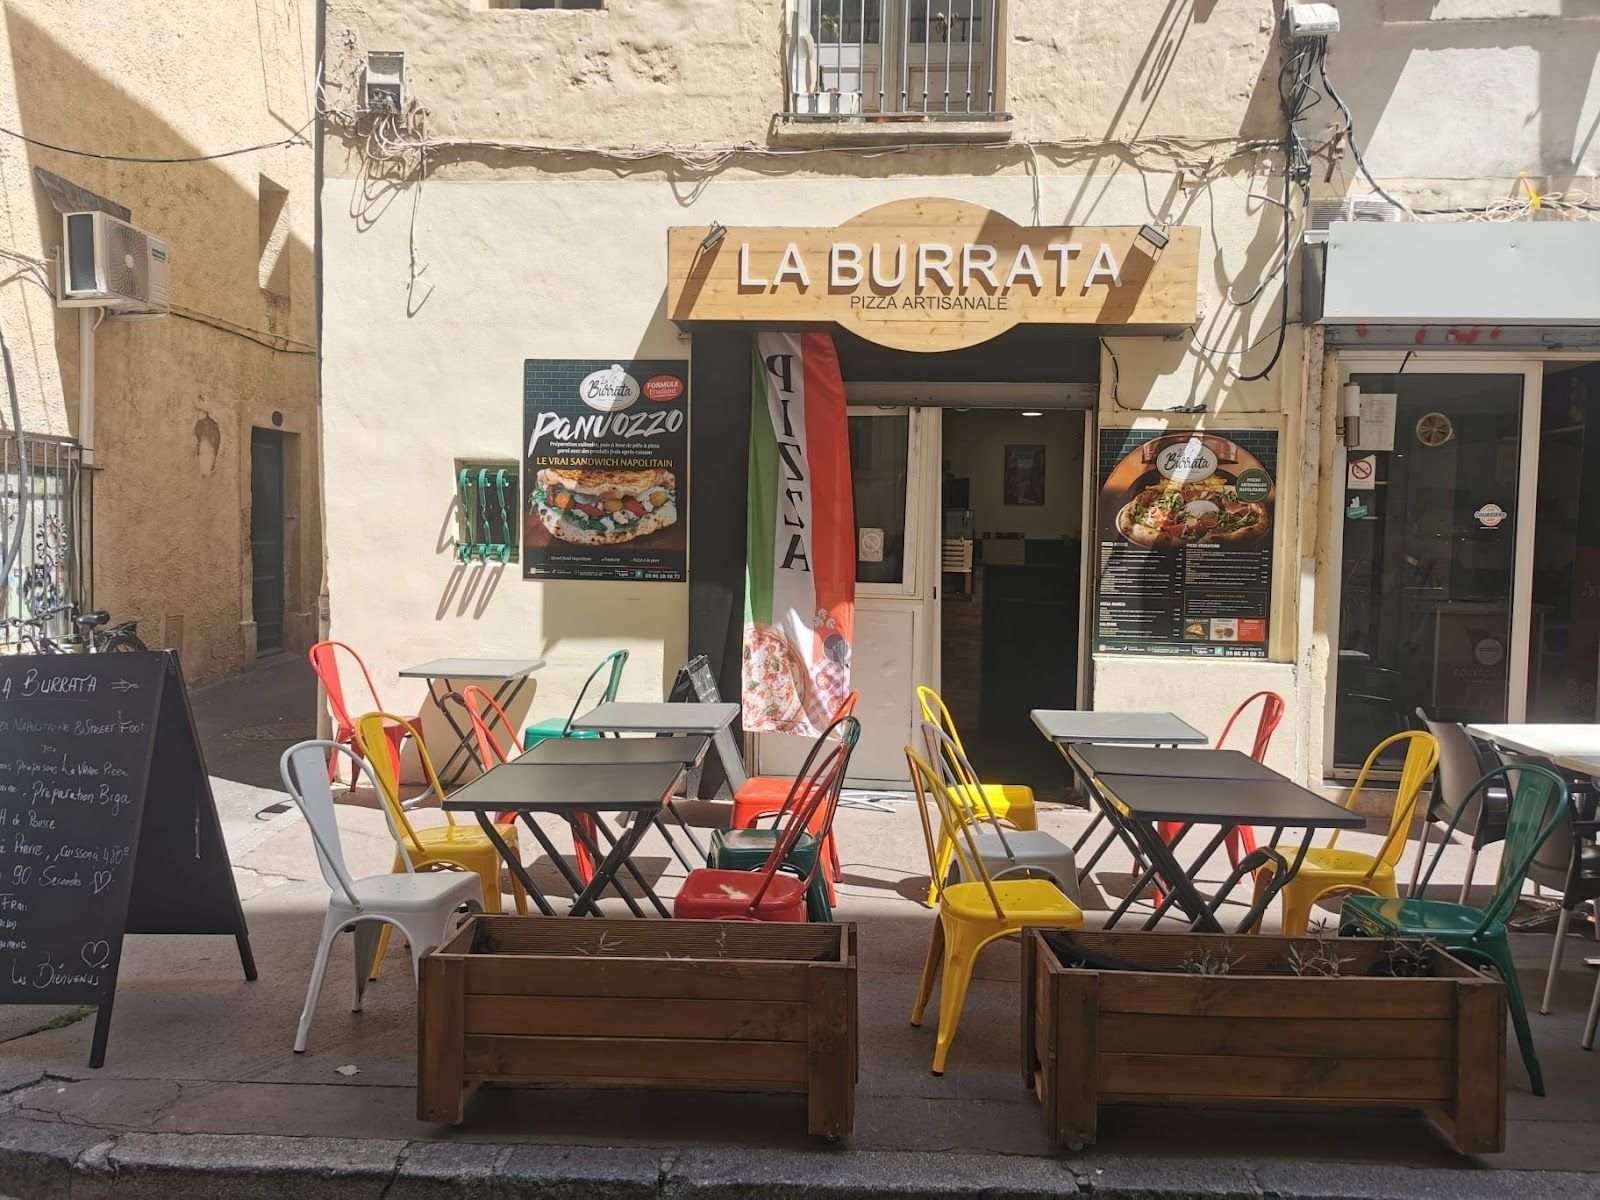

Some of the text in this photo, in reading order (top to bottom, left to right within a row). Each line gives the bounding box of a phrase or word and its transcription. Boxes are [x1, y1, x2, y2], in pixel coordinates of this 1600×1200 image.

[740, 243, 1122, 289] LA BURRATA
[850, 296, 1008, 311] PIZZA ARTISANALE
[587, 379, 633, 398] Burrata
[647, 381, 679, 389] FORMULE
[537, 457, 673, 468] LE VRAI SANDWICH NAPOLITAIN
[1164, 453, 1210, 471] Burrata
[21, 668, 97, 697] BURRATA
[12, 864, 32, 886] 90
